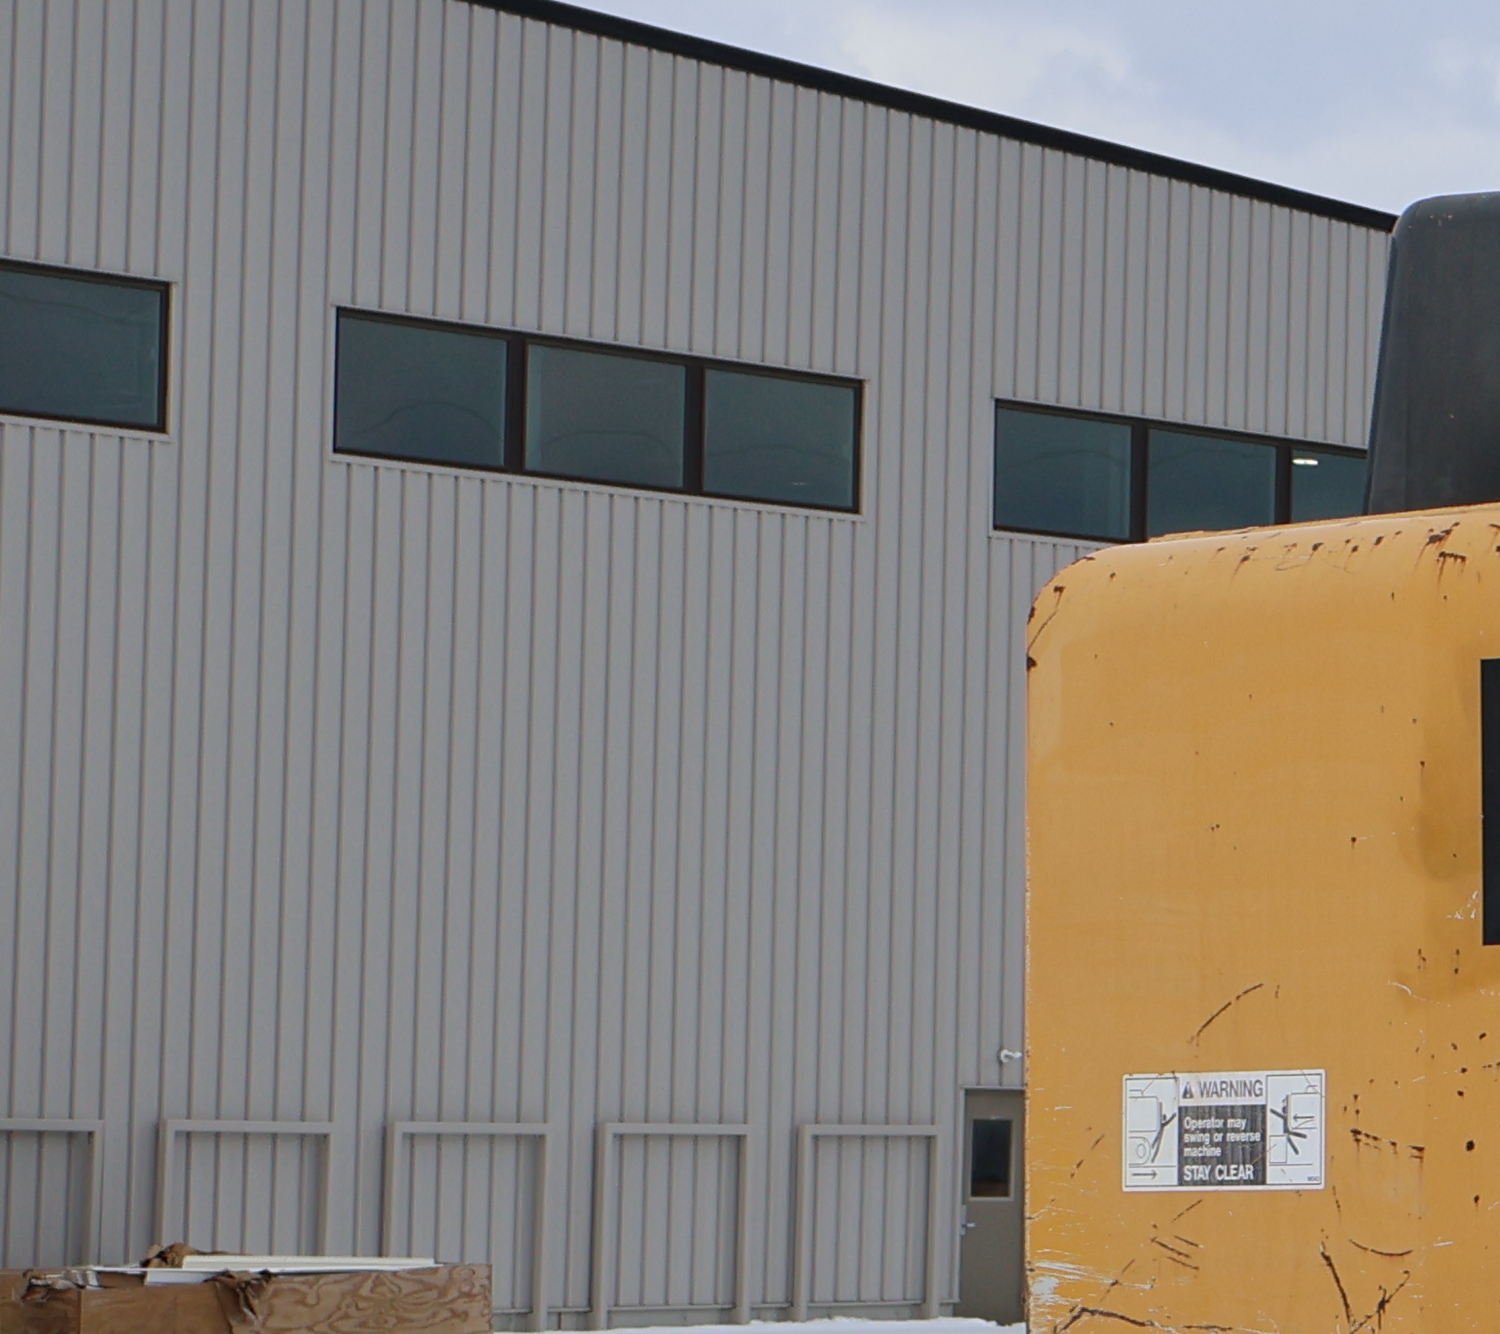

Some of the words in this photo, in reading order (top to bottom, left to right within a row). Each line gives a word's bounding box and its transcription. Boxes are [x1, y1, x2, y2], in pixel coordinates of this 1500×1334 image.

[1199, 1079, 1264, 1099] WARNING
[1184, 1116, 1224, 1131] Operator
[1227, 1118, 1247, 1130] may
[1184, 1130, 1211, 1145] swing
[1213, 1132, 1224, 1143] or
[1226, 1132, 1261, 1142] reverse
[1183, 1144, 1222, 1157] machine
[1183, 1165, 1211, 1181] STAY
[1215, 1164, 1254, 1181] CLEAR
